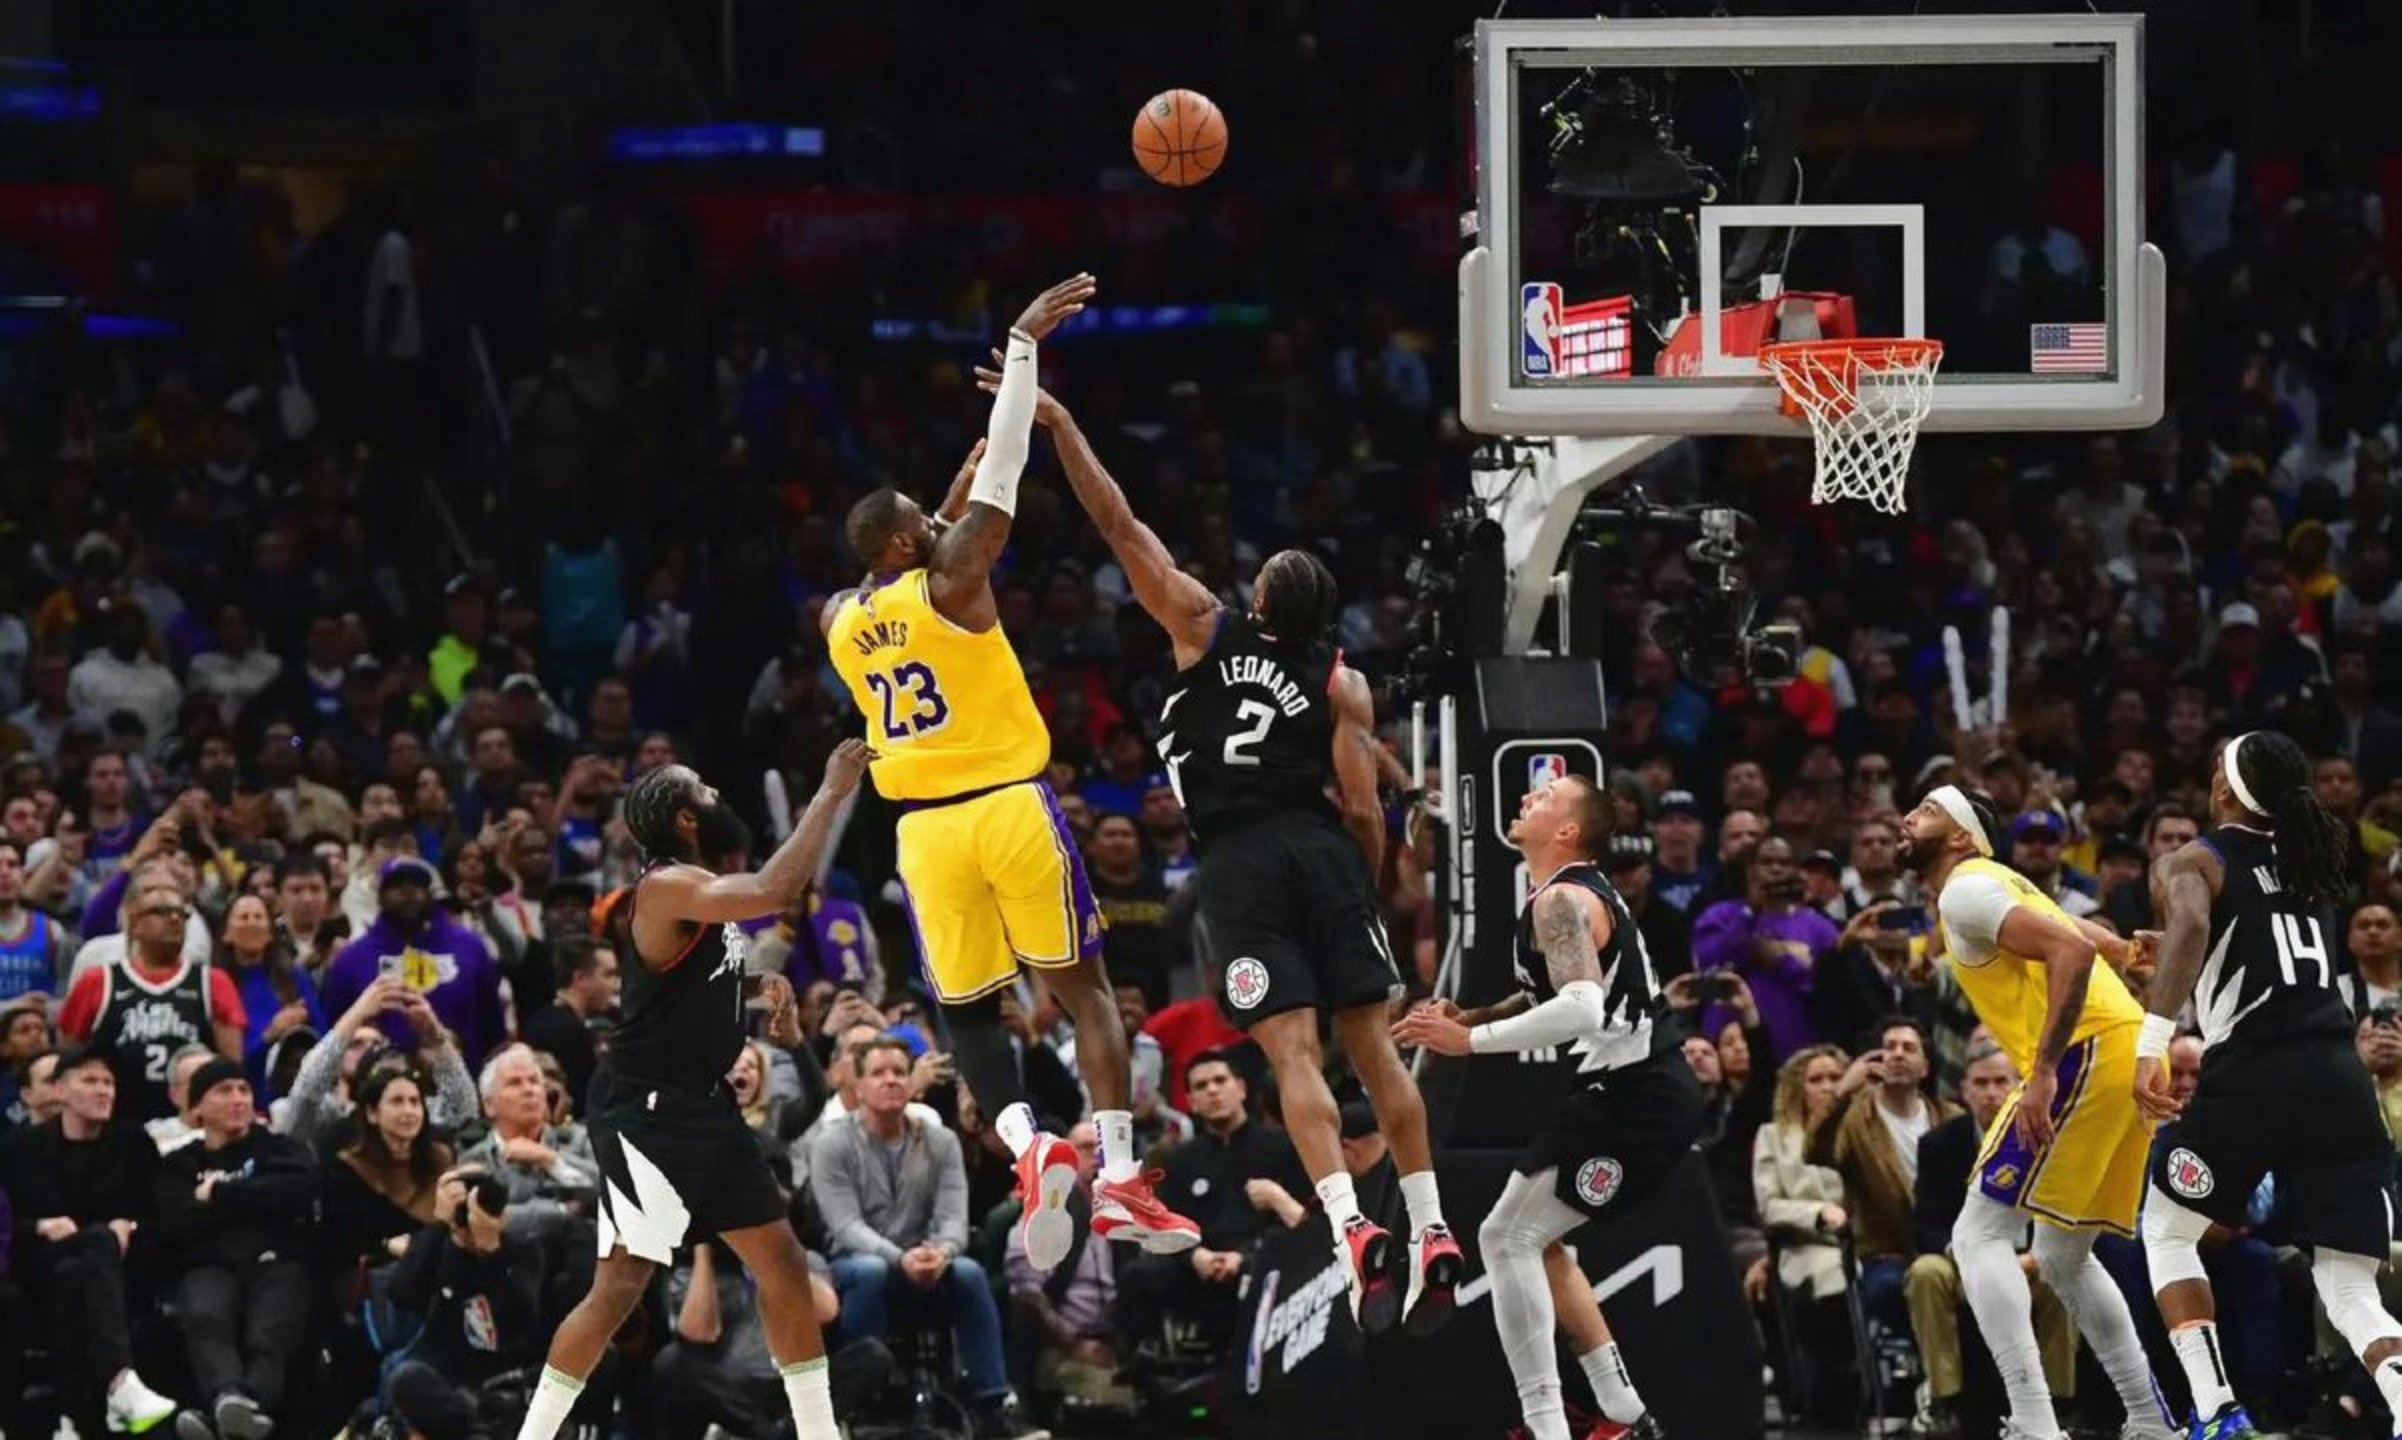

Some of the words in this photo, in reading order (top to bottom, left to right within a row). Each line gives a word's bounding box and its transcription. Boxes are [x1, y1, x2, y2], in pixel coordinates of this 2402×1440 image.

[852, 620, 908, 656] JAMES
[863, 658, 950, 740] 23
[1219, 655, 1311, 718] LEONARD
[1223, 698, 1277, 766] 2
[2271, 911, 2330, 989] 14
[144, 1044, 169, 1082] 2
